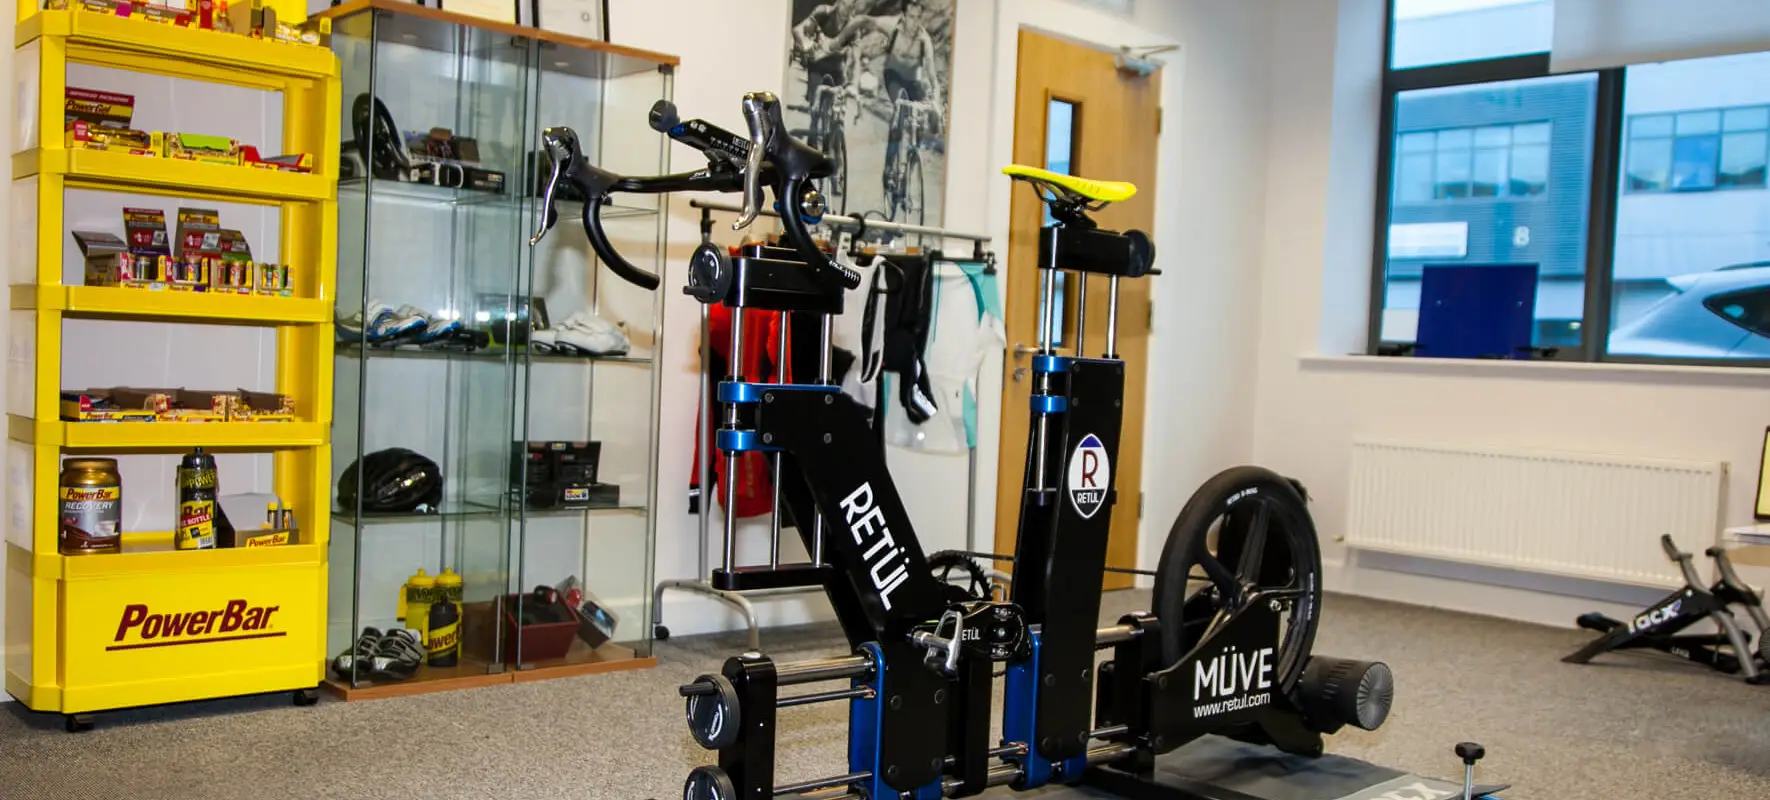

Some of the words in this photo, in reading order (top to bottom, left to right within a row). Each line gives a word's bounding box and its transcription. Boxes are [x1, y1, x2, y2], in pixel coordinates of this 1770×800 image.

[66, 99, 112, 114] PowerGel
[1513, 226, 1530, 247] 8
[1082, 450, 1099, 488] R
[66, 488, 113, 500] PowerBar
[65, 501, 113, 510] RECOVERY
[249, 534, 286, 548] PowerBar
[840, 481, 910, 611] RETÜL
[114, 599, 280, 642] PowerBar
[962, 627, 980, 641] ETÜL
[1194, 645, 1273, 701] MÜVE
[1194, 692, 1271, 719] www.retul.com
